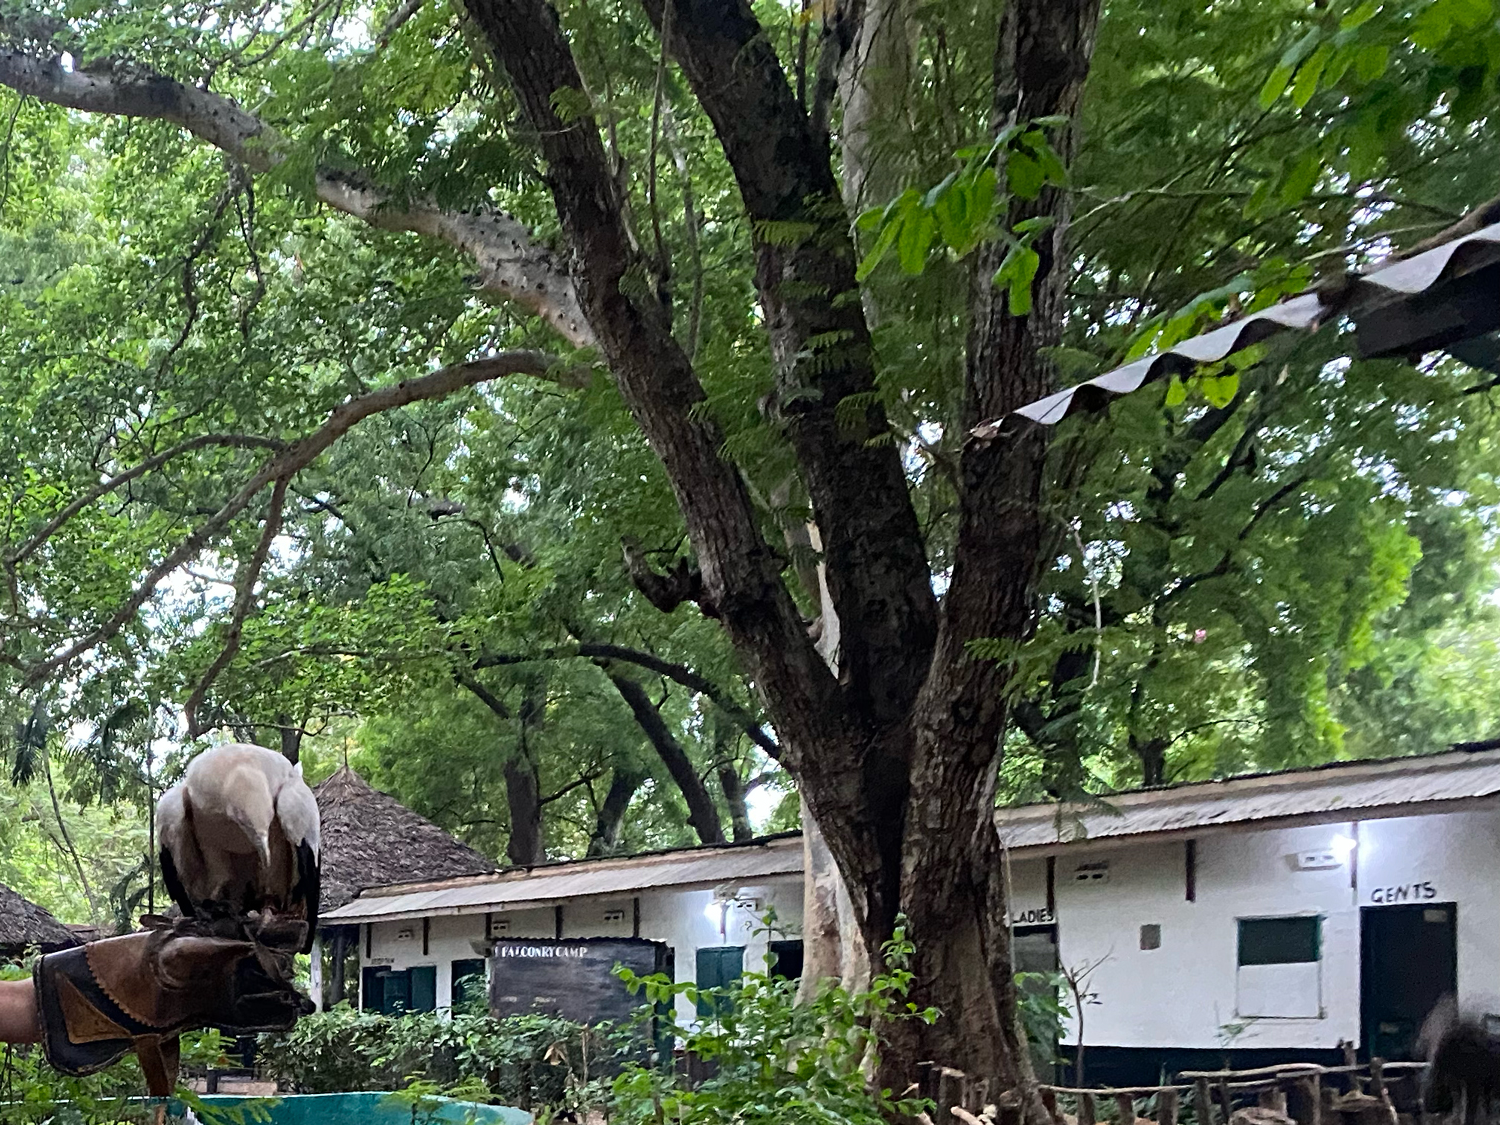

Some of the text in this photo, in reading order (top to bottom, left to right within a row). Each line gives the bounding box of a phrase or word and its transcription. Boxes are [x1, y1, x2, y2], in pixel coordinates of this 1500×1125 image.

[1371, 881, 1437, 903] GENTS
[1012, 908, 1054, 923] LADIES
[502, 945, 555, 958] FALCONRY
[556, 945, 588, 958] CAMP
